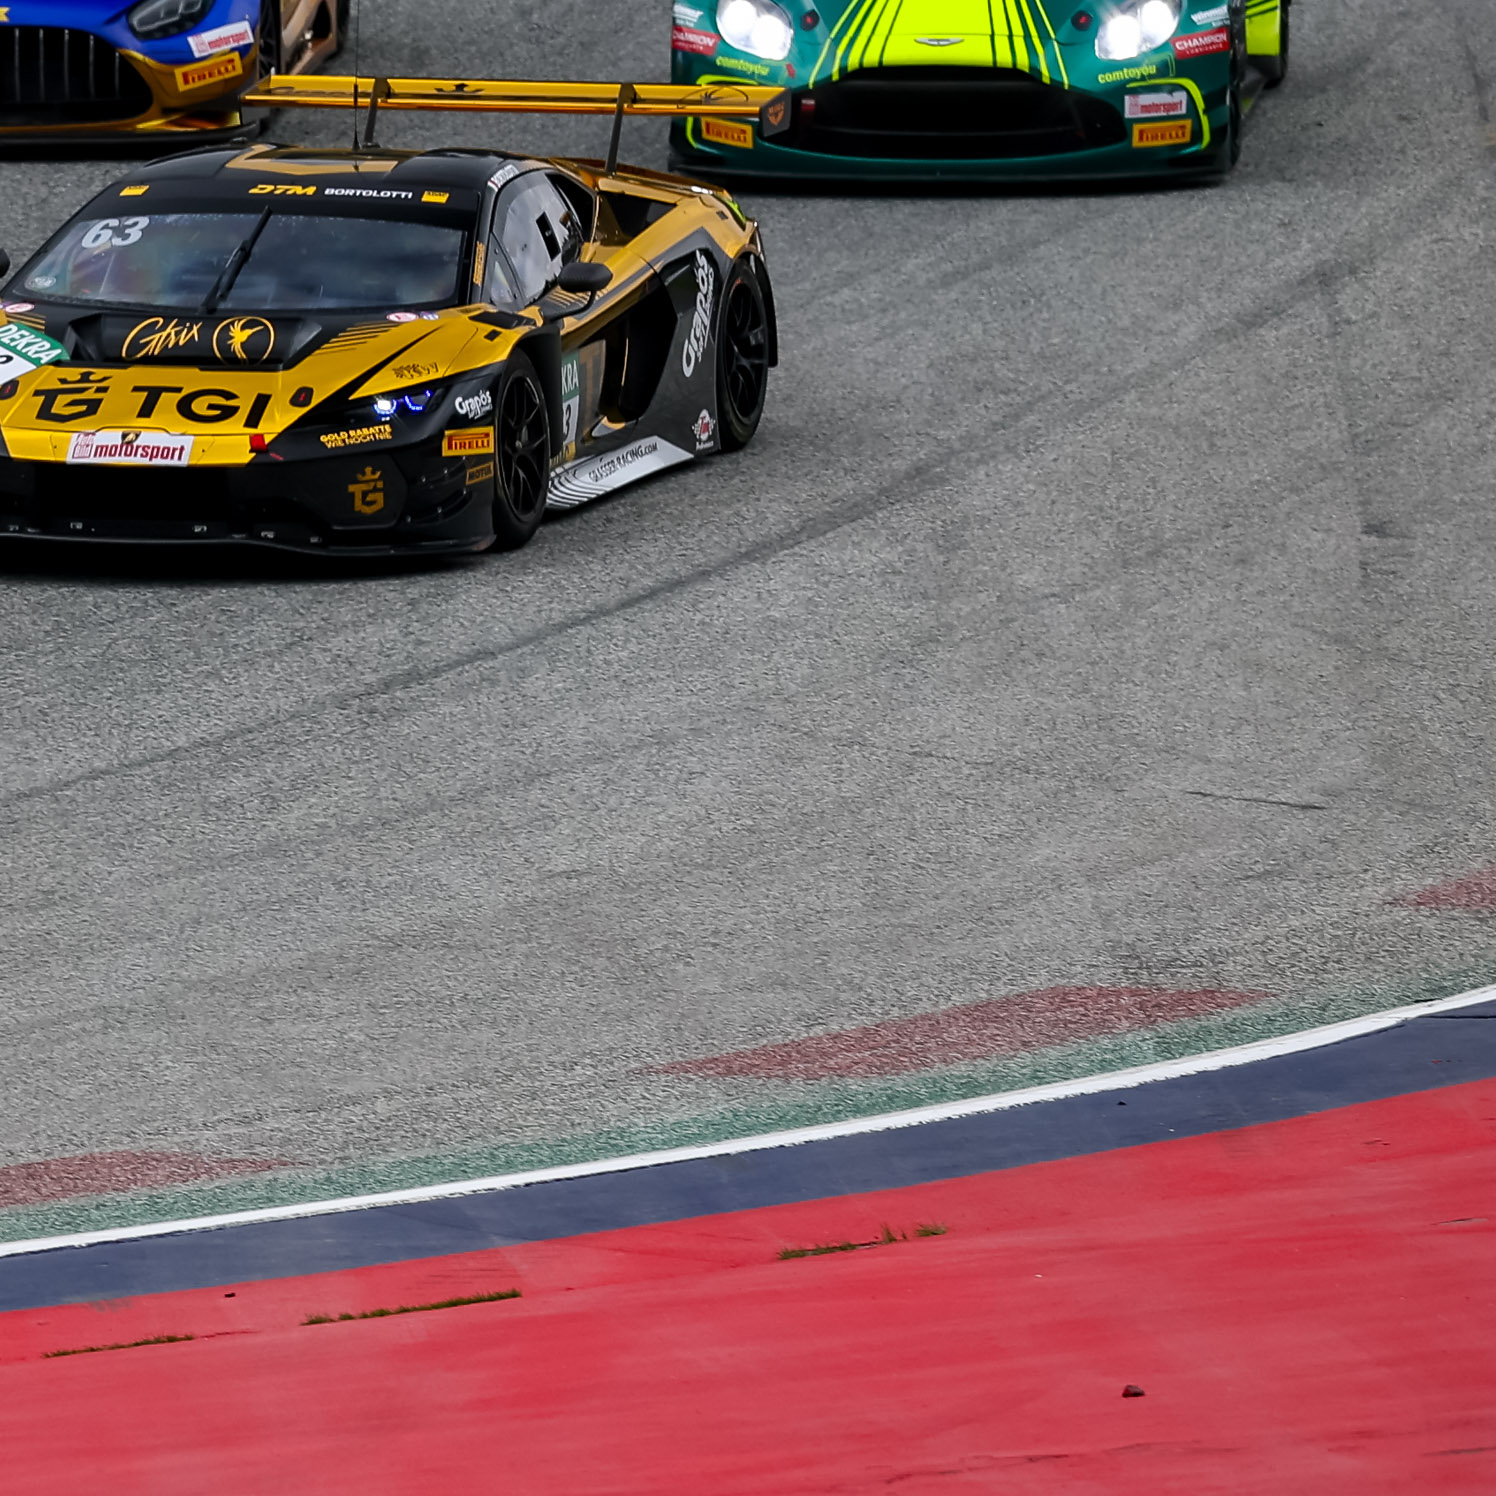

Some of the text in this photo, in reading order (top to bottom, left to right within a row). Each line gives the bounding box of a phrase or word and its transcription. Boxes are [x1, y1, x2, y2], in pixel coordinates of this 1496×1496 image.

[208, 31, 249, 48] motorsport
[1175, 33, 1227, 51] CHAMPION
[182, 58, 236, 86] PIRELLI
[1098, 64, 1157, 84] comtoyou
[1141, 100, 1183, 114] motorsport
[707, 123, 749, 144] PIRELLI
[1138, 125, 1186, 143] PIRELLI
[247, 184, 317, 196] DTM
[323, 187, 414, 199] BORTOLOTTI
[80, 216, 151, 249] 63
[562, 366, 579, 396] KRA
[115, 387, 272, 428] TGI
[455, 389, 492, 419] Grapós
[565, 403, 572, 438] 3
[320, 424, 392, 443] GOLD RABATTE
[325, 430, 392, 449] WIE NOCH NIE
[447, 432, 490, 450] PIRELLI
[94, 442, 185, 461] motorsport
[467, 465, 492, 482] MOTUL
